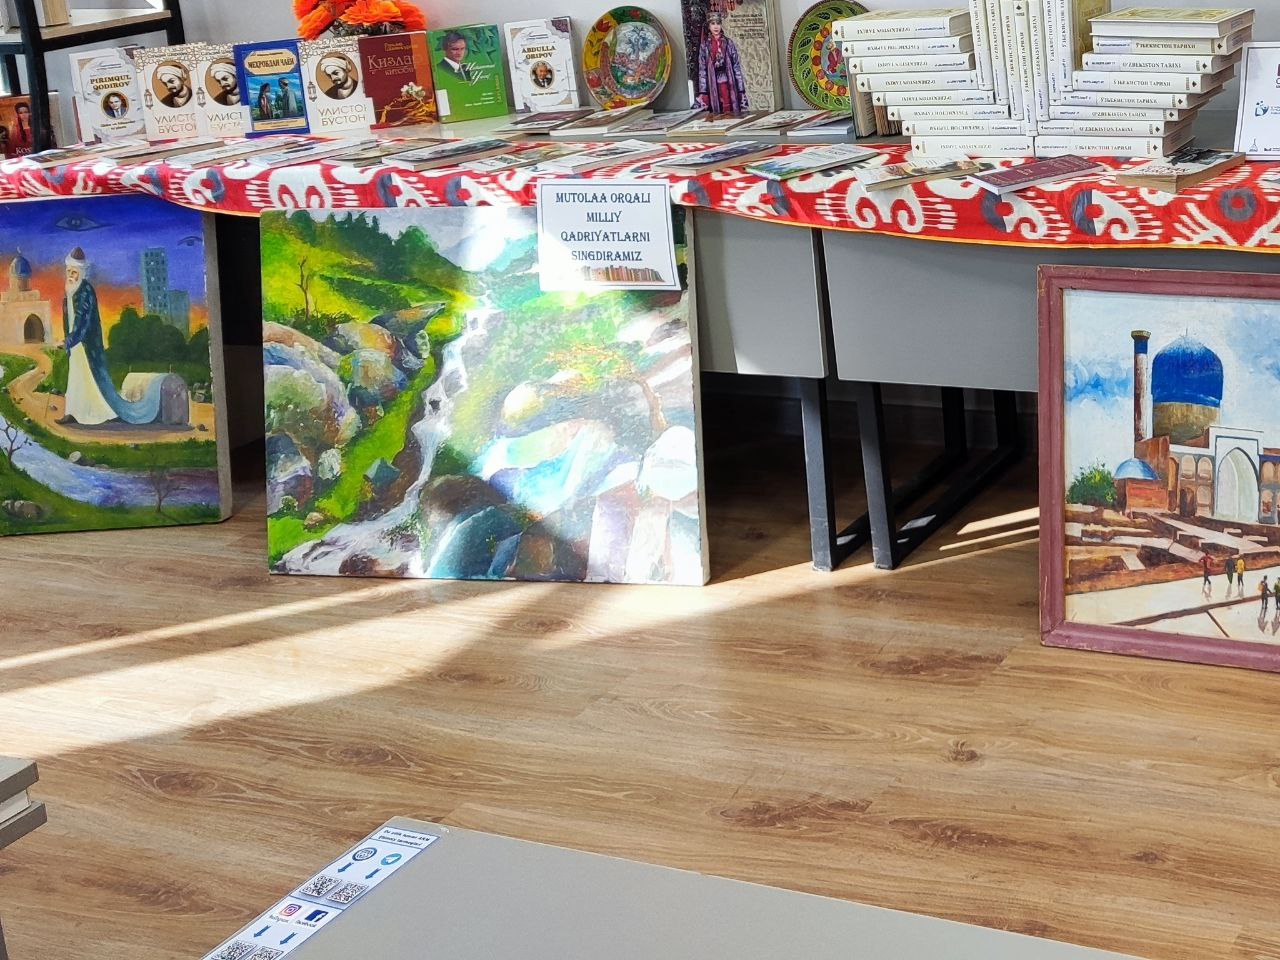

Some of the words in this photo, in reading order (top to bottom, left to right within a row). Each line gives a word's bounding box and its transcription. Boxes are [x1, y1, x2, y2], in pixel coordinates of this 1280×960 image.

[521, 45, 556, 54] ABDULLA
[525, 52, 553, 60] ORIPOV
[367, 54, 414, 75] Қизла
[90, 75, 132, 85] PIRIMQUL
[92, 81, 131, 91] QODIROV
[155, 113, 196, 125] УЛИСТО
[207, 111, 242, 122] УЛИСТ
[321, 116, 366, 127] БУСТОН
[556, 192, 607, 203] MUTOLAA
[610, 192, 651, 204] ORQALI
[586, 210, 622, 223] MILLIY
[560, 230, 650, 243] QADRIYATLARNI
[571, 250, 643, 262] SINGDIRAMIZ
